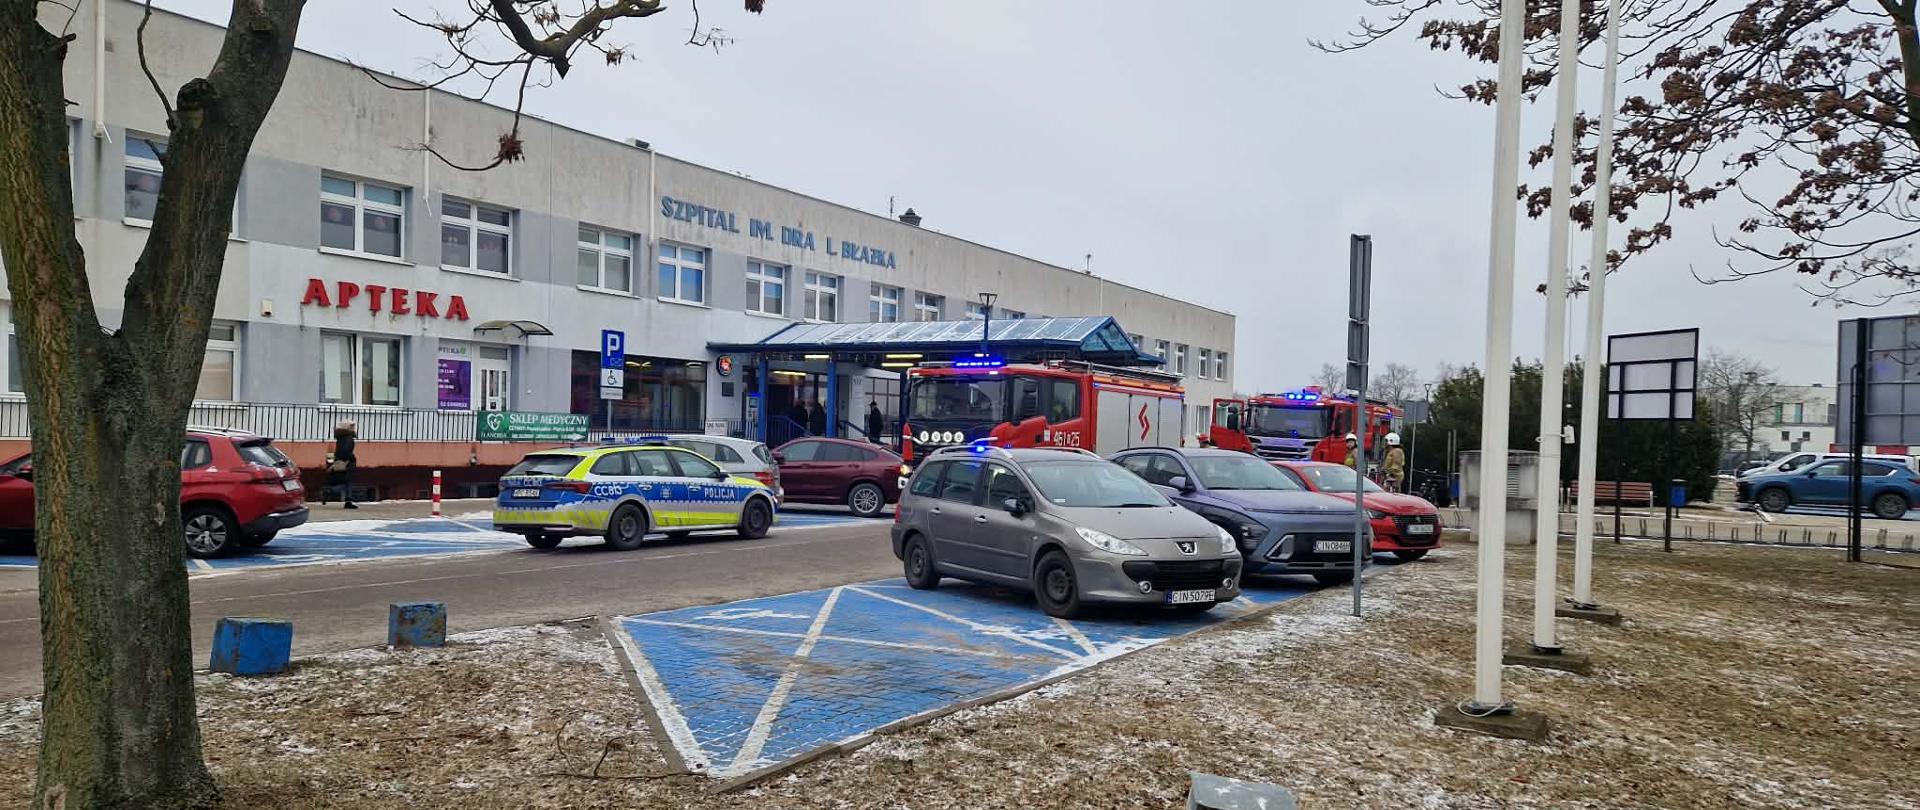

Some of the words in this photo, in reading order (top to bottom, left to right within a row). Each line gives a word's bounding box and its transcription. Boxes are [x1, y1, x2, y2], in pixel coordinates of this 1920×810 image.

[661, 196, 740, 233] SZPITAL
[781, 225, 815, 251] DRA
[301, 278, 470, 320] APTEKA
[607, 333, 620, 357] P
[509, 414, 539, 425] SKLEP
[540, 415, 587, 425] MEDYCZNY
[704, 487, 735, 499] POLICJA
